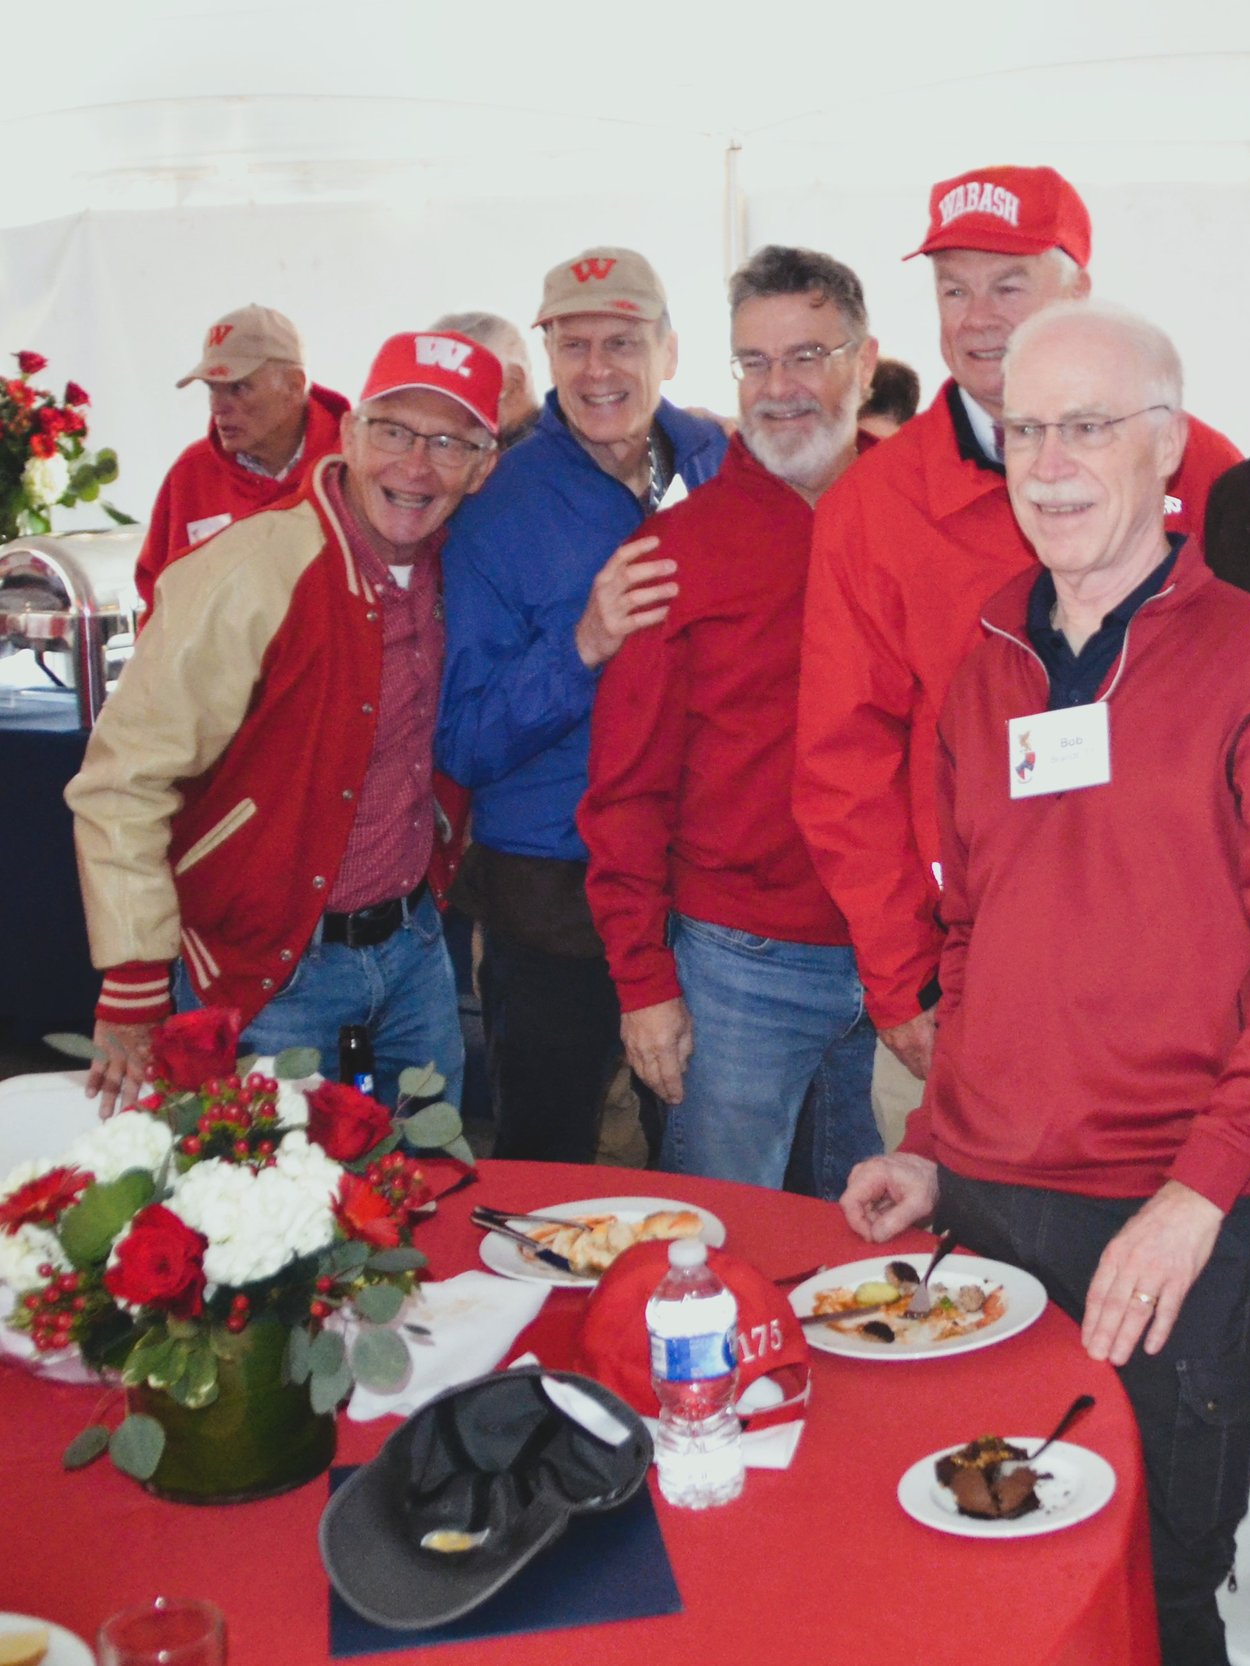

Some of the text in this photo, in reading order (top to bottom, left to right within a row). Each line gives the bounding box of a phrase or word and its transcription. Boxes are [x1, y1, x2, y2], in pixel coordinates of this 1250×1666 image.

[939, 181, 1020, 228] WABASH
[569, 257, 616, 283] W
[208, 323, 234, 347] W
[737, 1318, 784, 1364] 175
